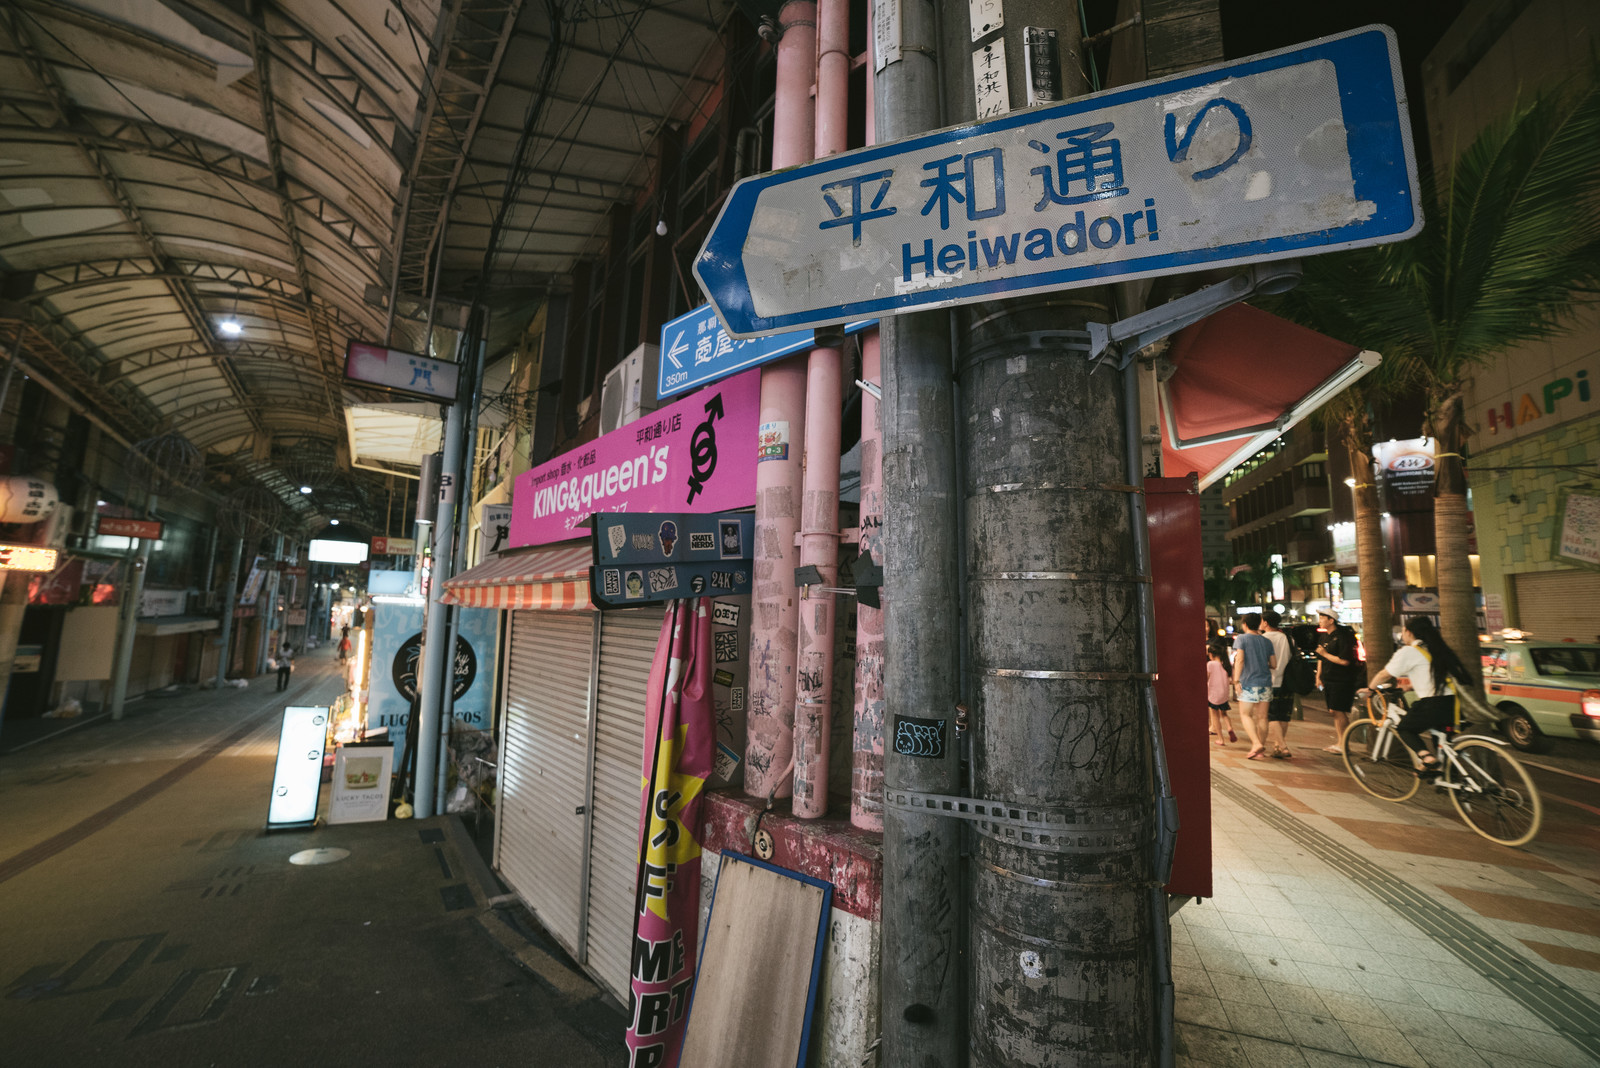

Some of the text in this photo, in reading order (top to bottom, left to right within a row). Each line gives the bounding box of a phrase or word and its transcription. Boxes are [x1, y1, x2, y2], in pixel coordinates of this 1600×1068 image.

[818, 98, 1253, 247] 平和通り
[902, 199, 1159, 283] Heiwadori
[665, 371, 688, 388] 350m
[636, 413, 682, 445] 平和通り店
[441, 475, 452, 487] B
[533, 445, 669, 520] KING&queen's
[691, 534, 713, 542] SKATE
[691, 541, 714, 549] NERDS
[711, 572, 731, 589] 24K
[380, 711, 482, 727] LUC COS
